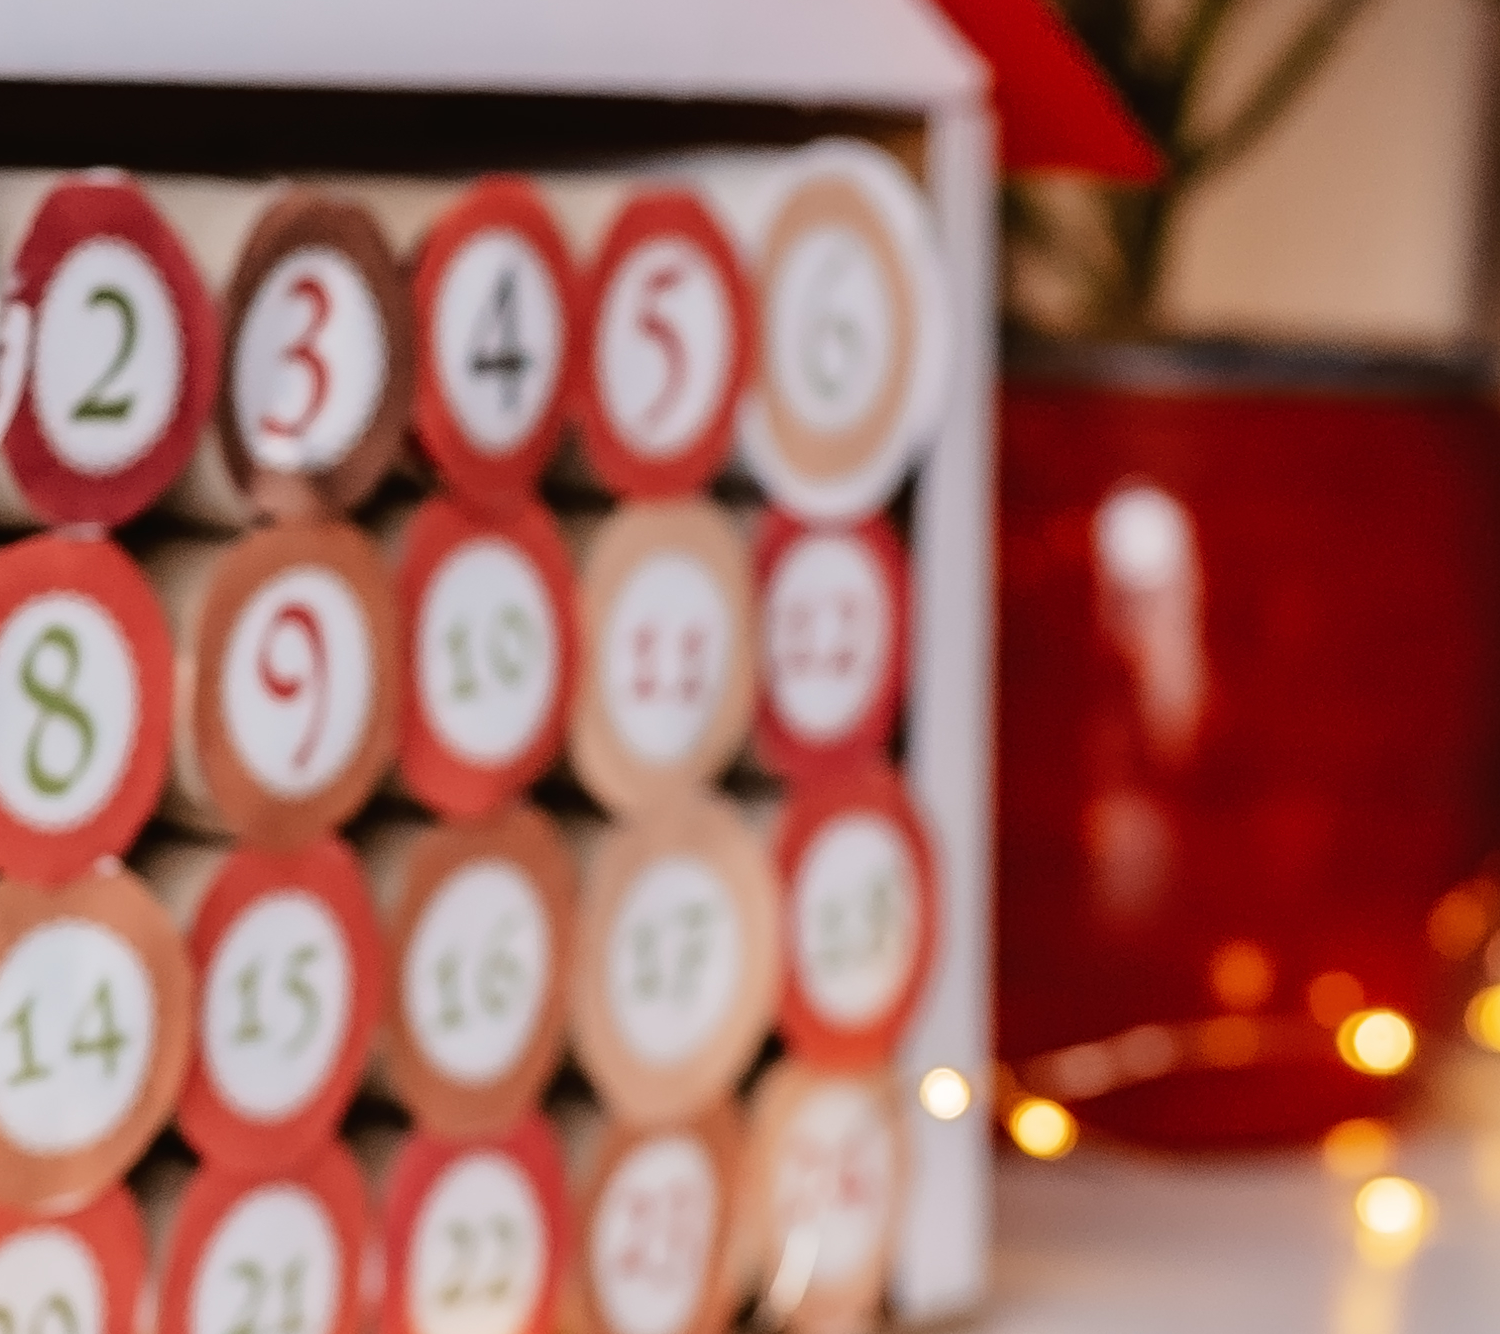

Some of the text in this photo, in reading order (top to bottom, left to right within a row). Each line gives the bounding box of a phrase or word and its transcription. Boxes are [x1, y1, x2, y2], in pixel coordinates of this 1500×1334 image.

[71, 284, 137, 422] 2
[259, 275, 332, 437] 3
[468, 266, 532, 411] 4
[634, 266, 692, 427] 5
[19, 622, 94, 796] 8
[258, 602, 331, 769] 9
[445, 603, 537, 703] 10
[631, 622, 706, 703] 11
[4, 977, 127, 1086] 14
[229, 944, 321, 1057] 15
[435, 908, 522, 1034] 16
[443, 1216, 514, 1304] 22
